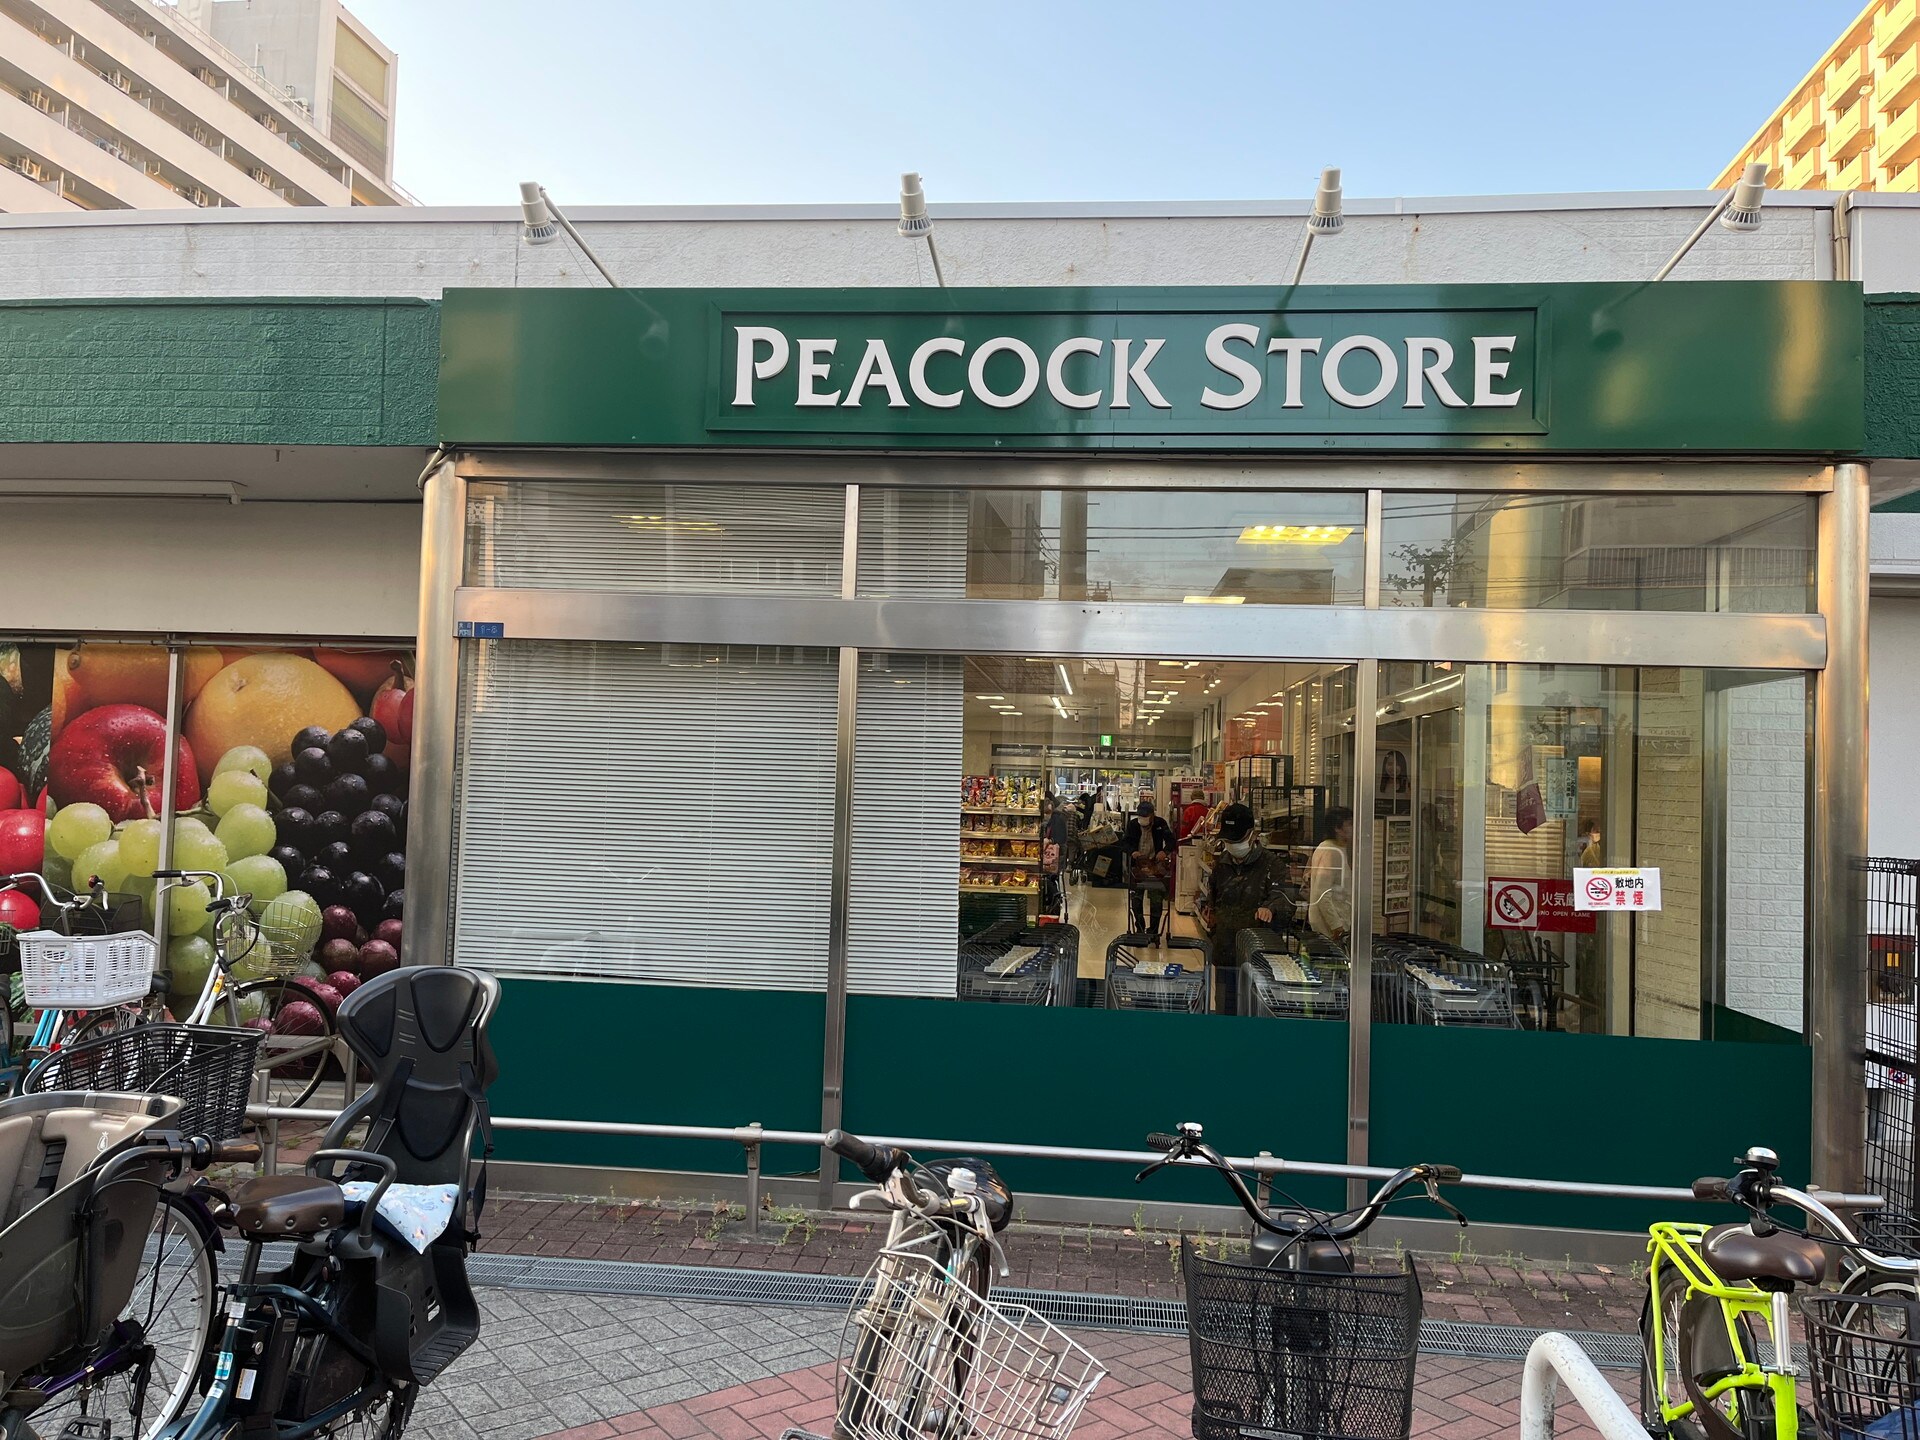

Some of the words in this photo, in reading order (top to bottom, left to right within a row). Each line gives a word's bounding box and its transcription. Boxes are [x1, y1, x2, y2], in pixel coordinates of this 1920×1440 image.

[731, 326, 1172, 409] PEACOCK
[1200, 323, 1523, 409] STORE
[1615, 877, 1644, 889] 敷地内
